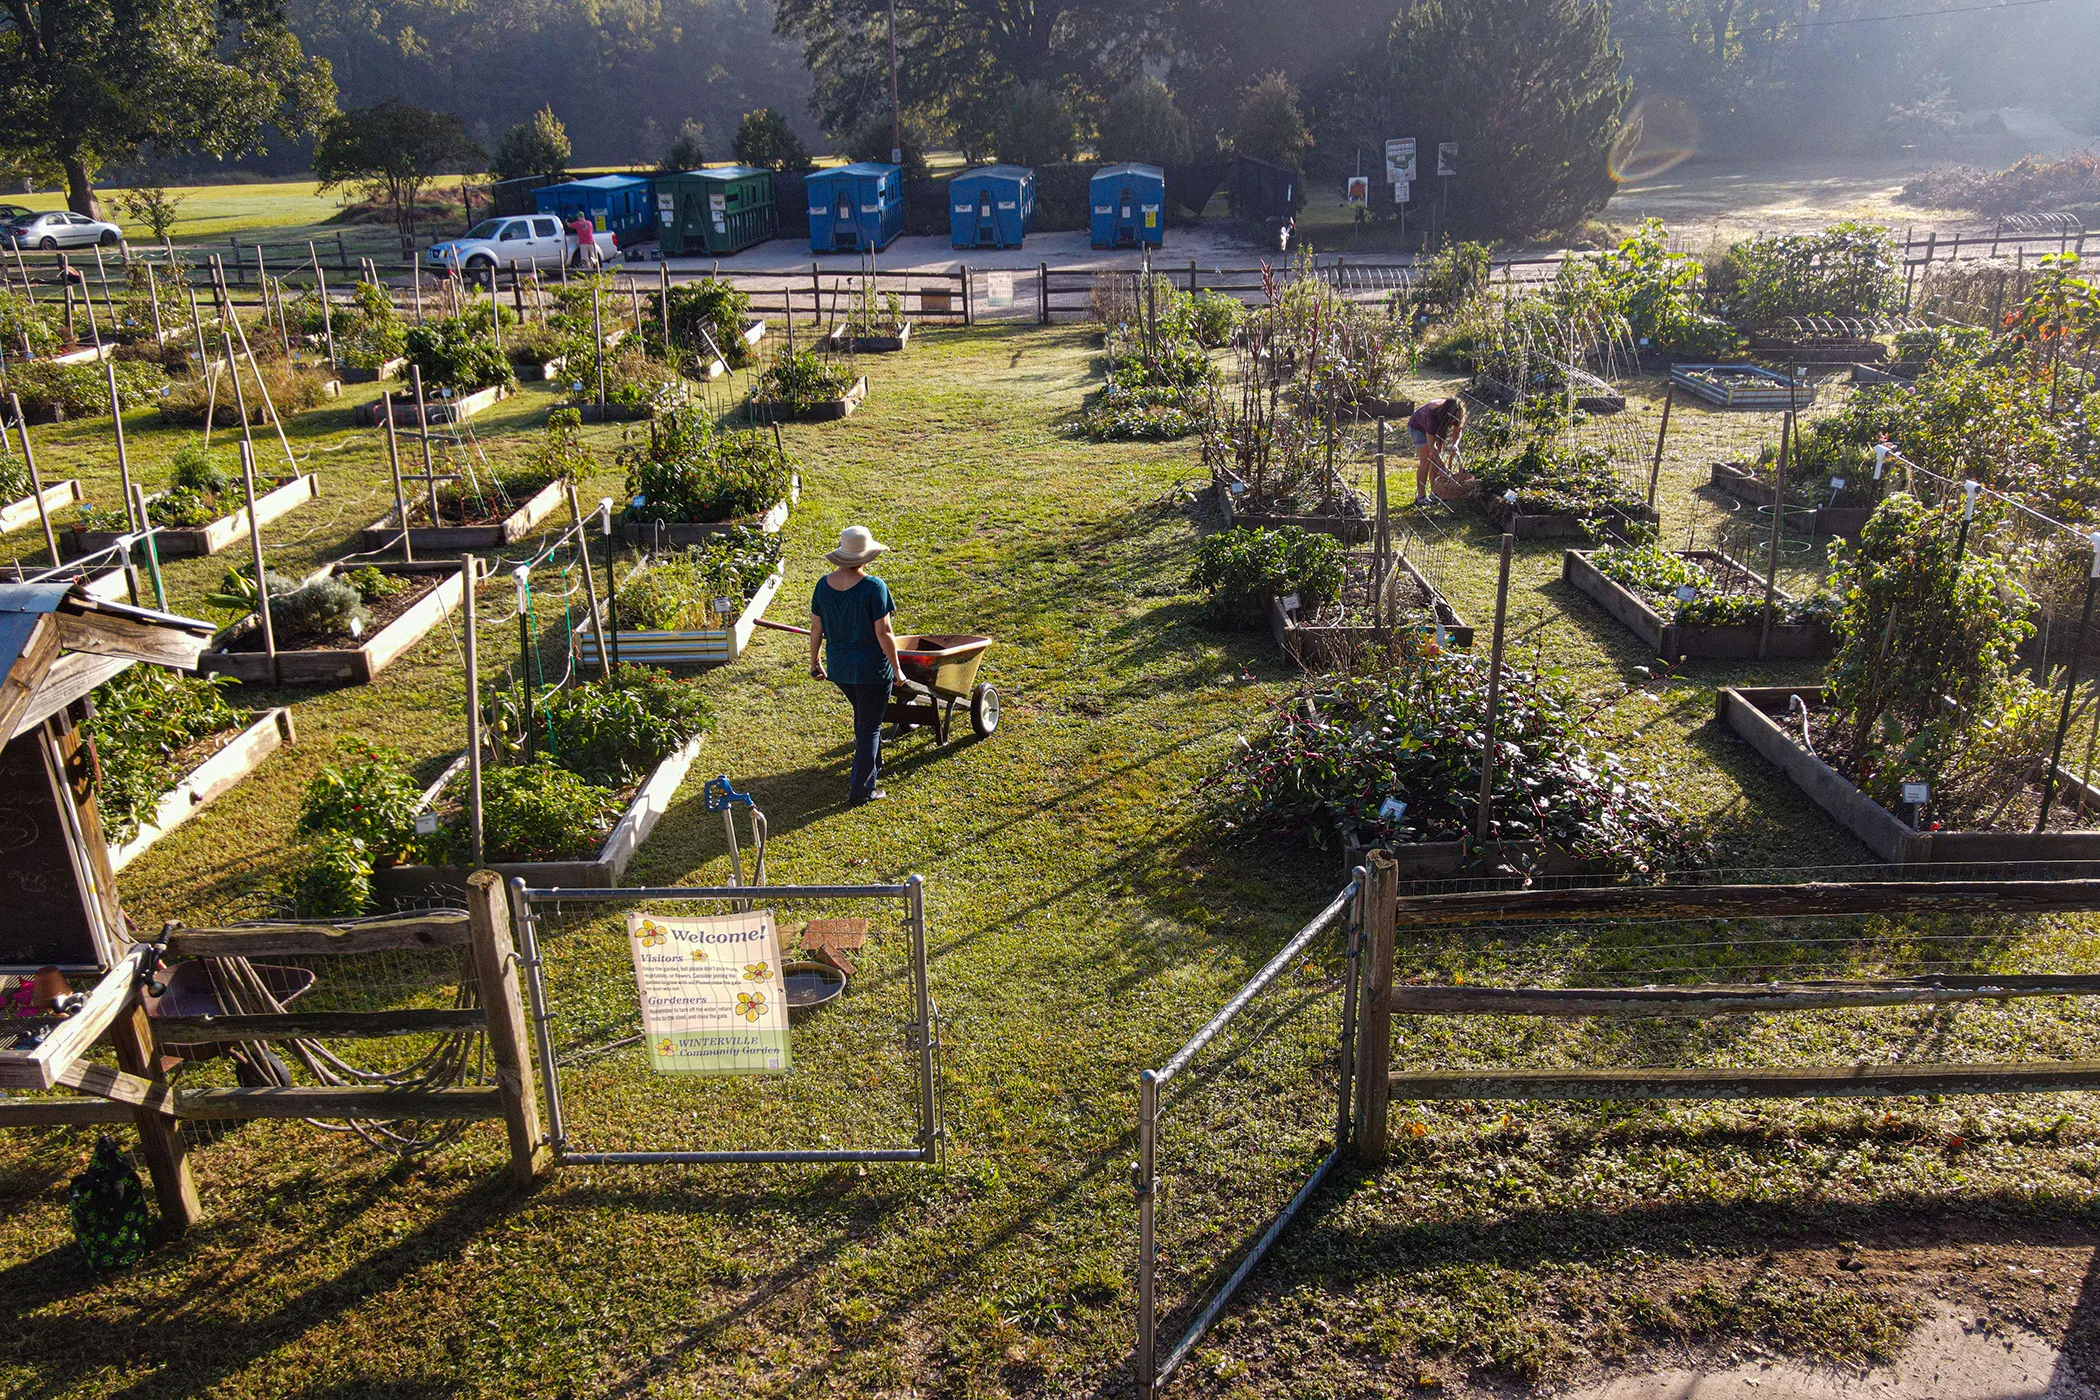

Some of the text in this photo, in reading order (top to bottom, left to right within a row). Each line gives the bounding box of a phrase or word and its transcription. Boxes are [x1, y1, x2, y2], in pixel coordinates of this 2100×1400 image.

[672, 925, 766, 943] Welcome!
[641, 954, 683, 962] Visitors
[648, 997, 707, 1005] Gardeners
[679, 1037, 758, 1047] WINTERVILLE
[680, 1046, 780, 1056] Community Garden
